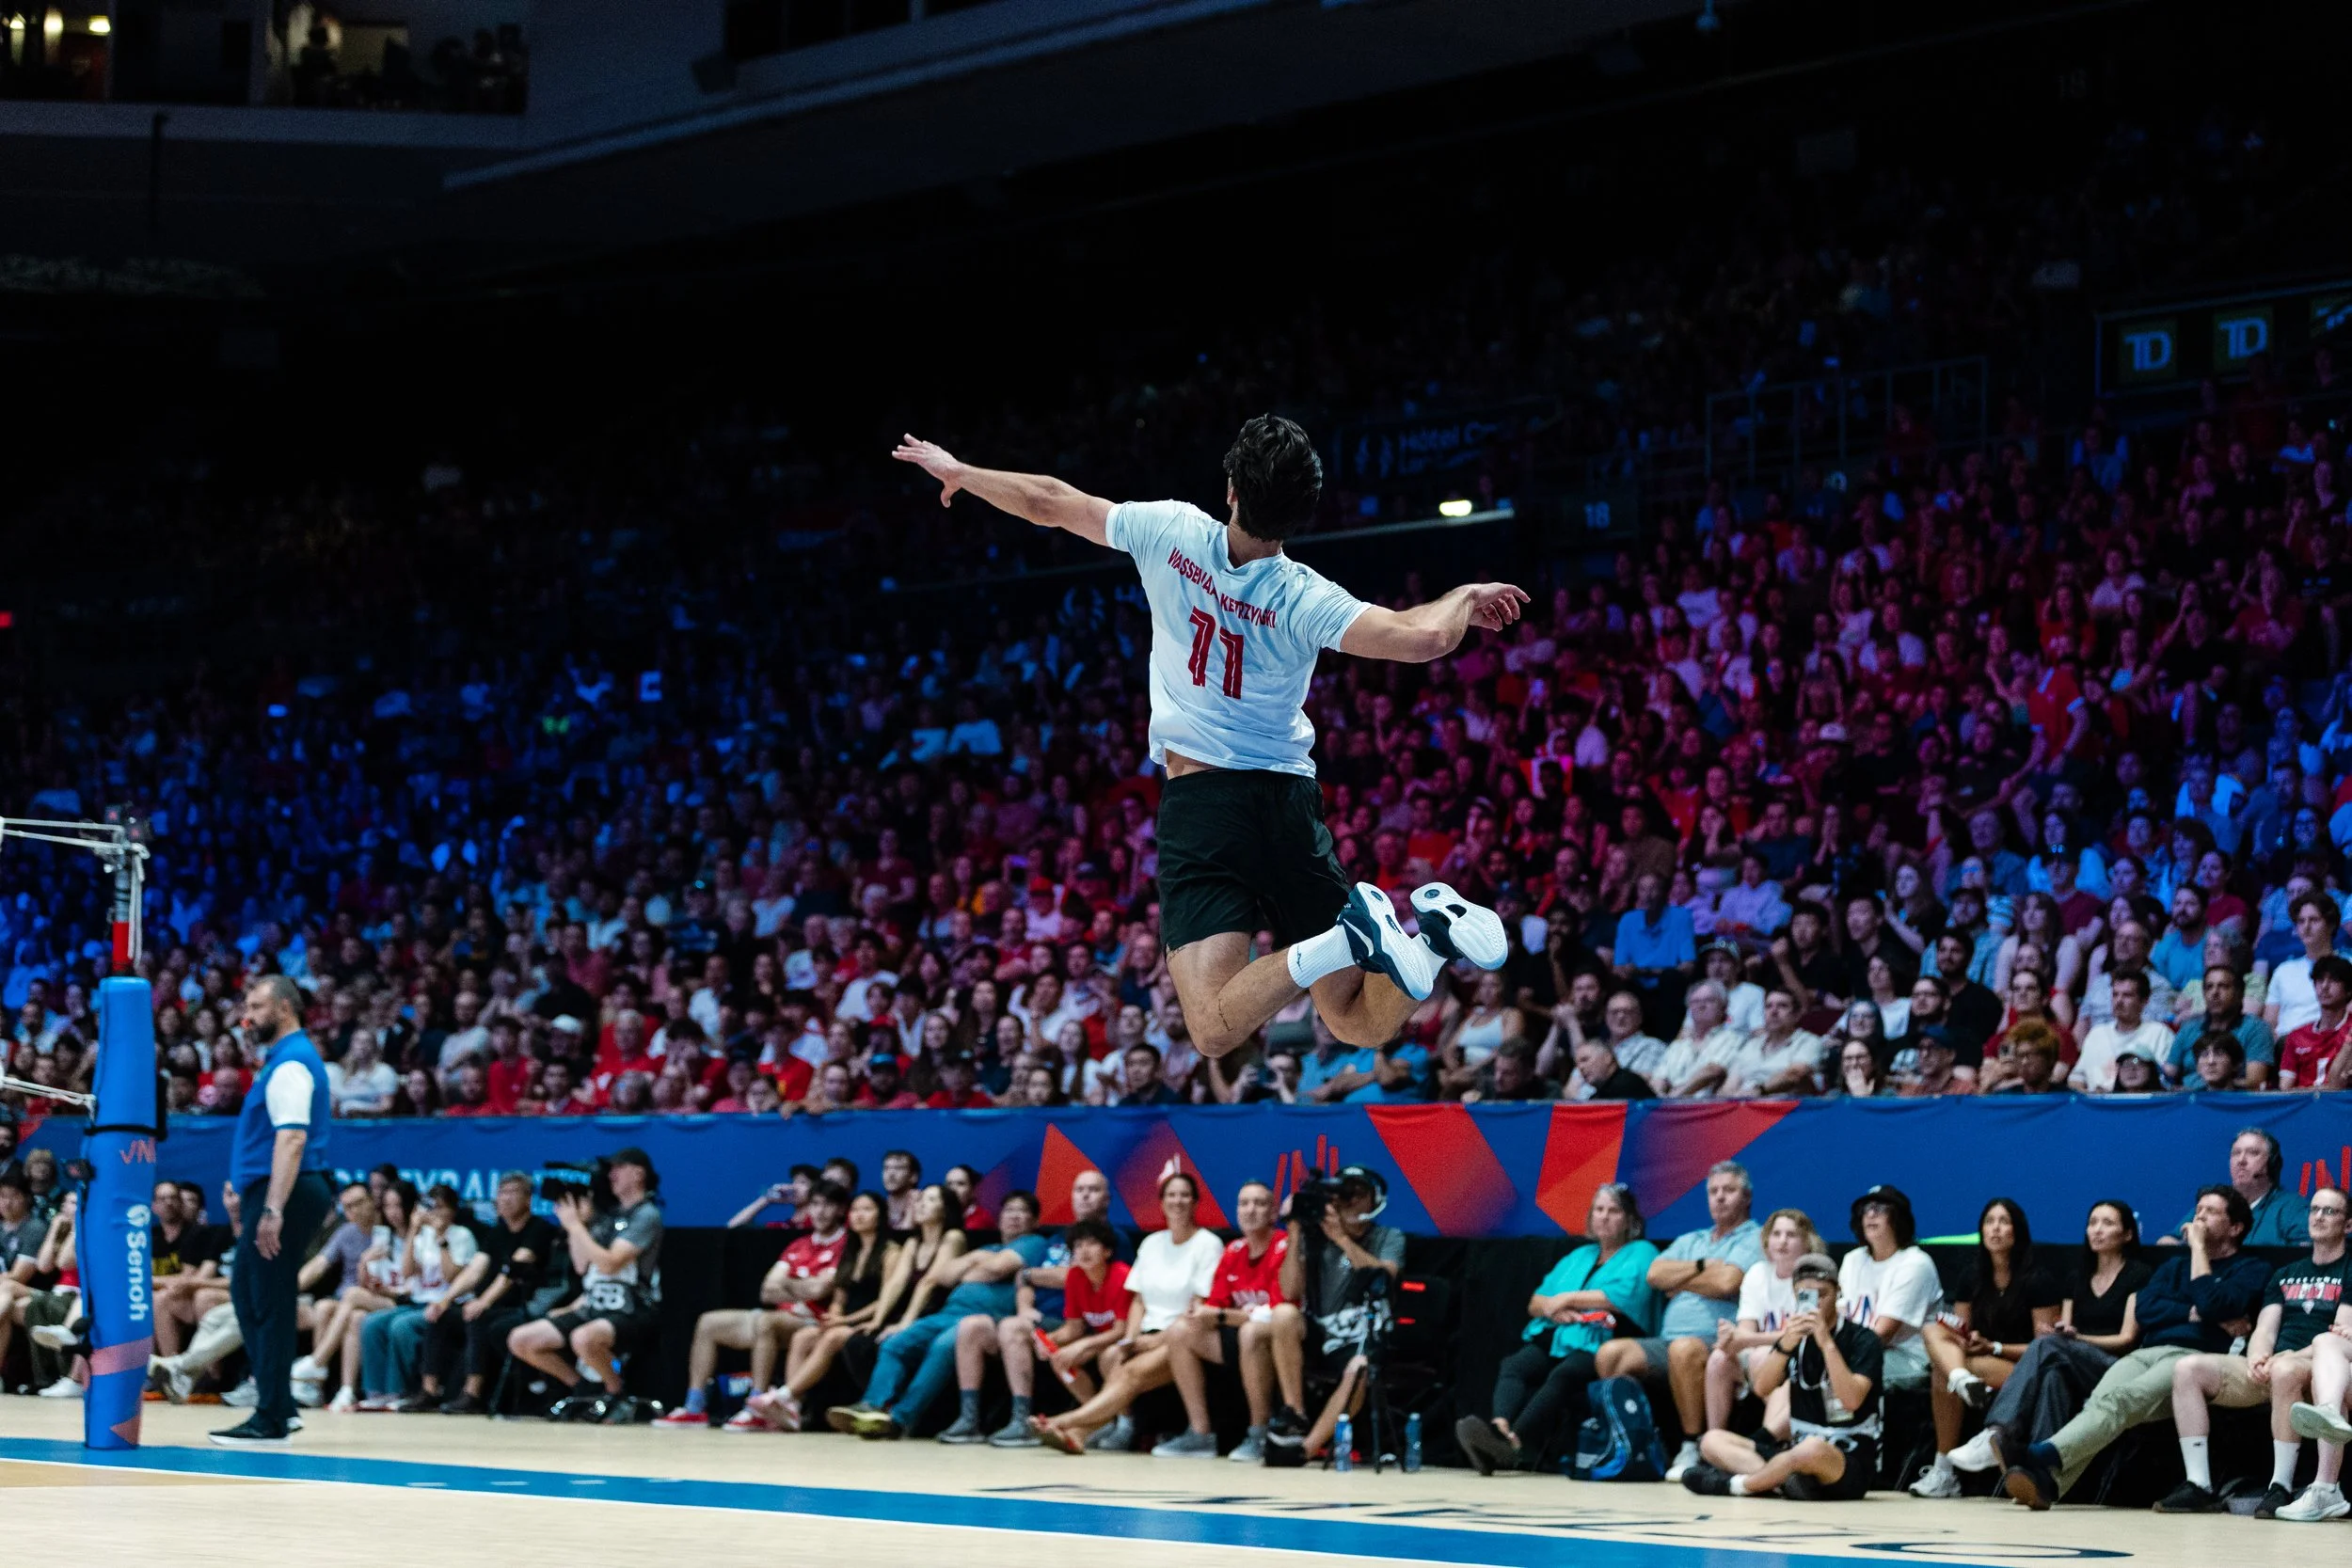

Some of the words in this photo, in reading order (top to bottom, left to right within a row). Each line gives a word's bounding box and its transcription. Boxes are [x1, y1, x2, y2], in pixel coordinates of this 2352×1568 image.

[2122, 330, 2172, 372] TD
[2218, 317, 2268, 359] TD
[1188, 606, 1245, 700] 11
[126, 1228, 150, 1322] Senoh
